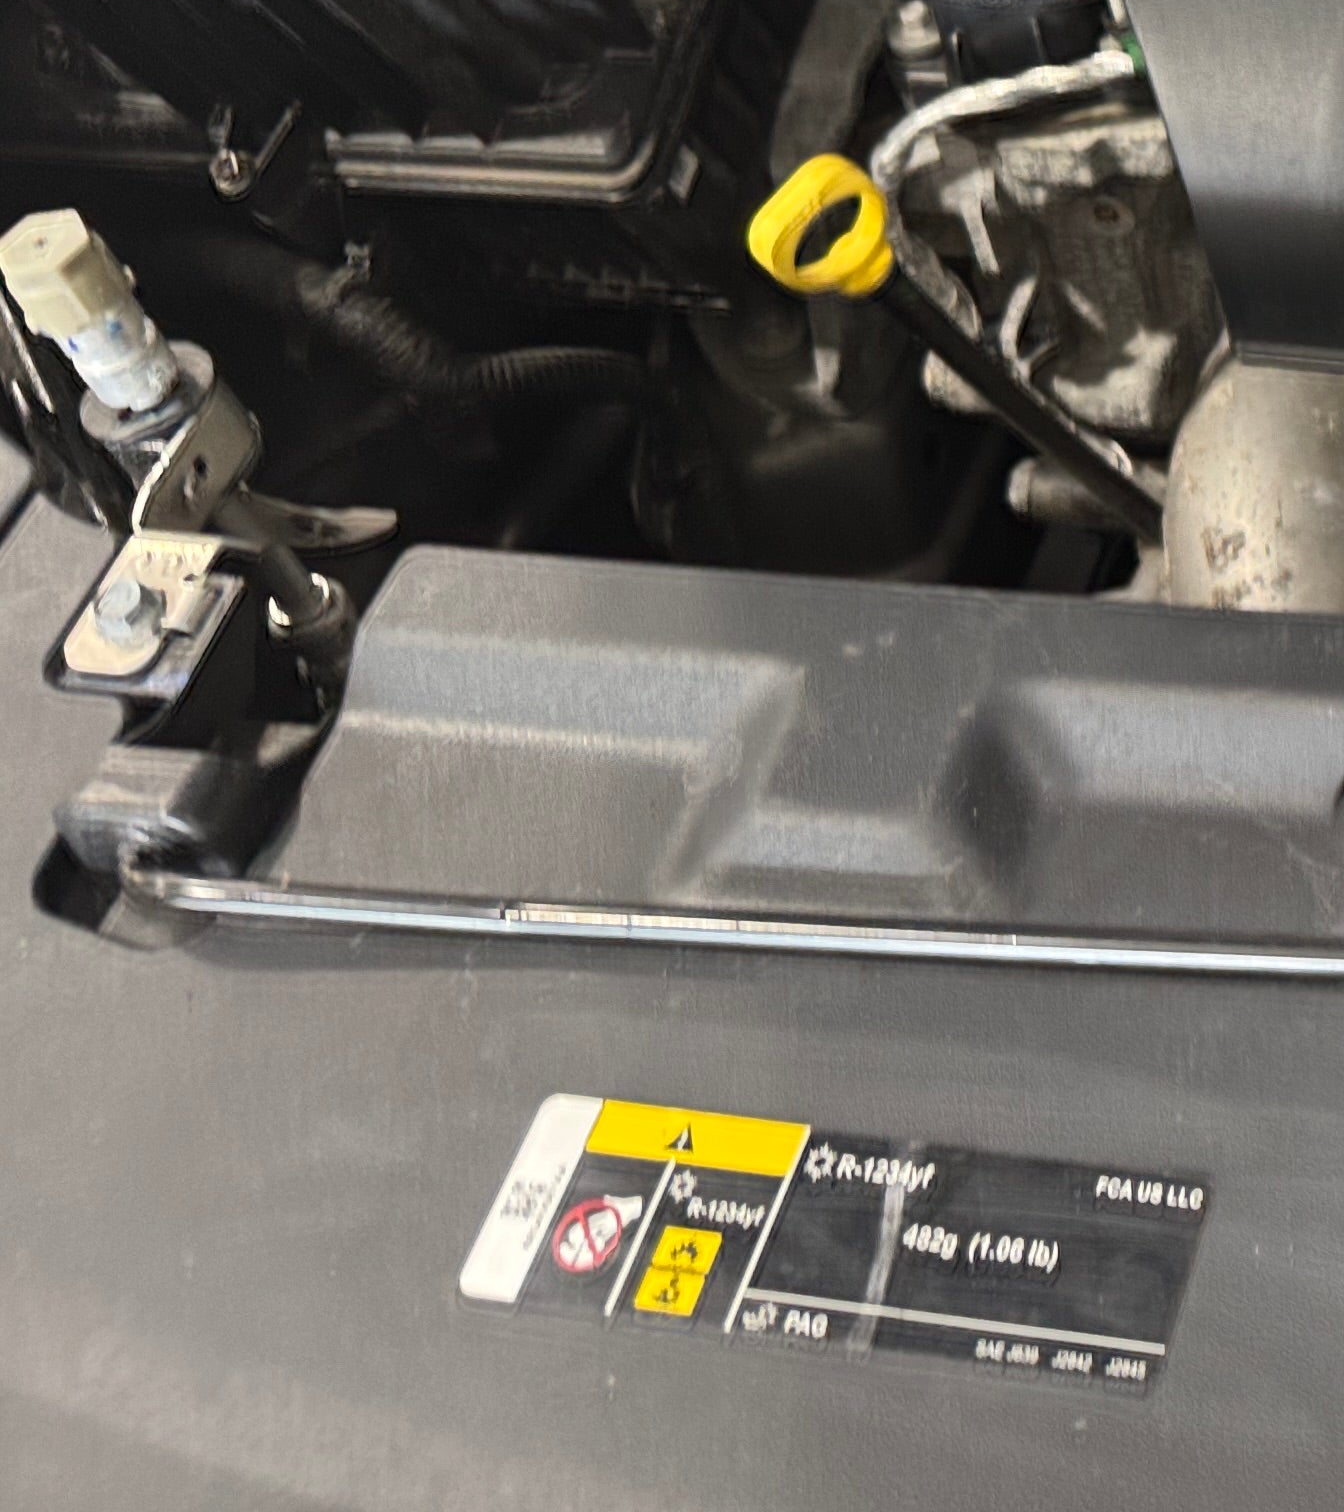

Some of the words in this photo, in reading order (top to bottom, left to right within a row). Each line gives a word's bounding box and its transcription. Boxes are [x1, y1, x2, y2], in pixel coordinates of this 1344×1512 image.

[837, 1152, 936, 1194] R-1234yf
[1095, 1175, 1133, 1202] FCA
[1137, 1180, 1164, 1206] US
[1166, 1184, 1205, 1211] LLC
[1028, 1239, 1060, 1274] lb)
[784, 1309, 830, 1340] PAG
